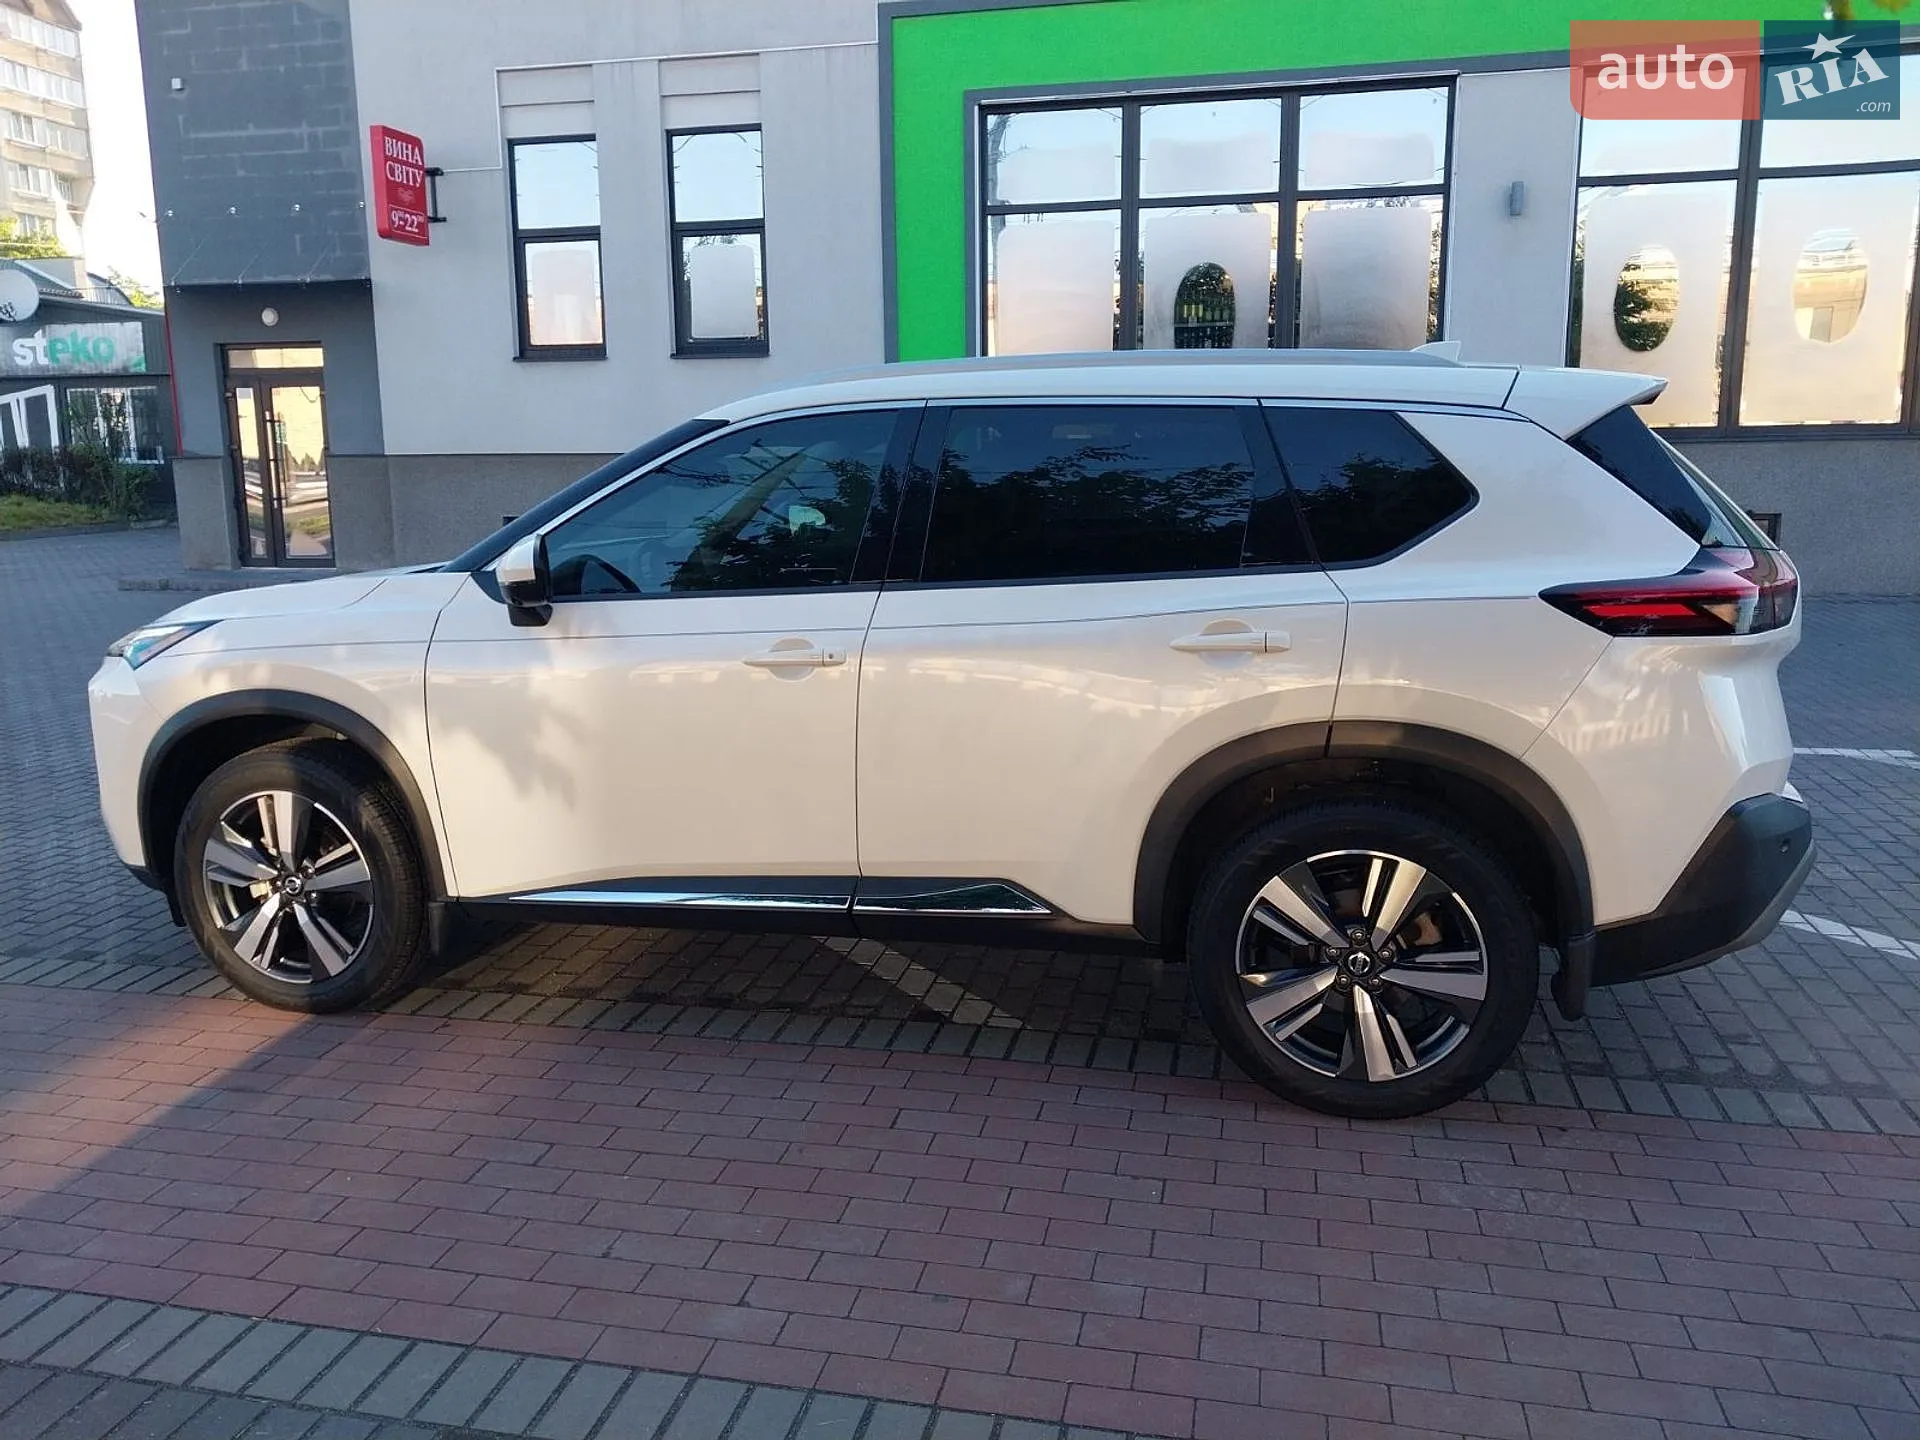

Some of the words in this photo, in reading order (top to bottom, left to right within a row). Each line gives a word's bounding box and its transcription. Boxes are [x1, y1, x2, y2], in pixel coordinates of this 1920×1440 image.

[385, 136, 422, 165] ВИНА
[386, 161, 424, 187] СВІТУ
[12, 329, 115, 366] steko
